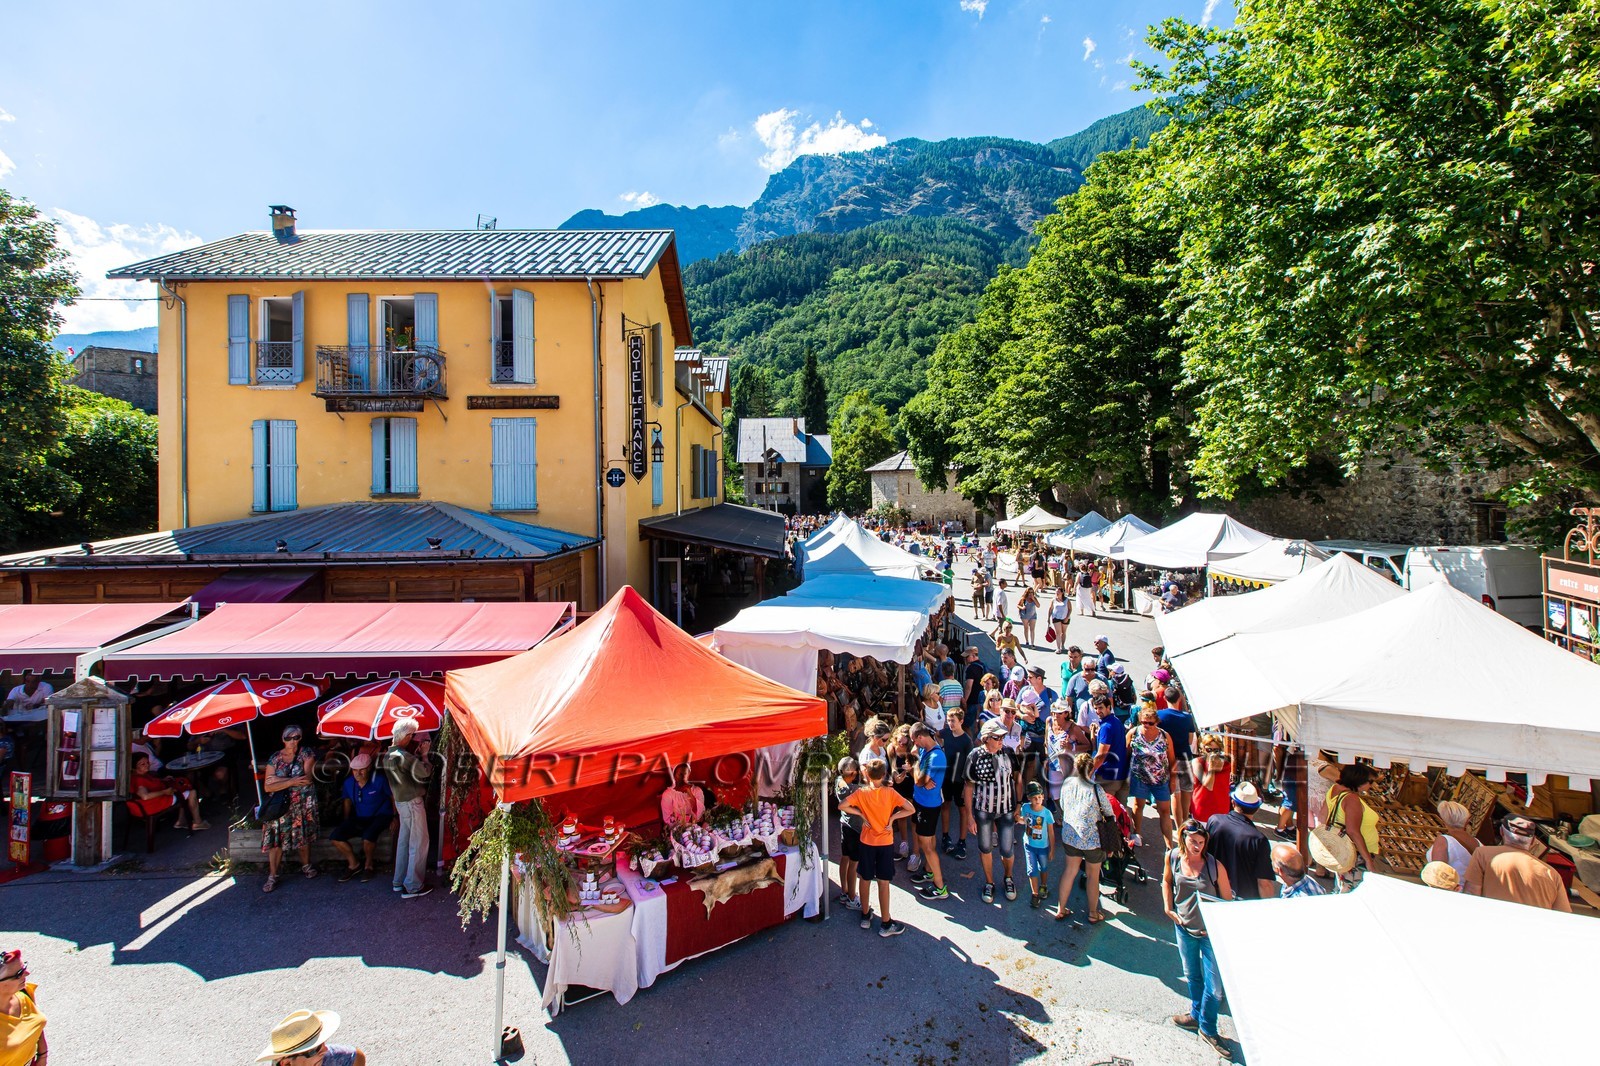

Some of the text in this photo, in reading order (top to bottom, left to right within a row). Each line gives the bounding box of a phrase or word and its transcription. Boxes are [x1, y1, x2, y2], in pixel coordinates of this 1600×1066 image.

[326, 399, 420, 412] RESTAURANT
[470, 398, 496, 409] BAR
[631, 338, 643, 473] HOTEL LE FRANCE
